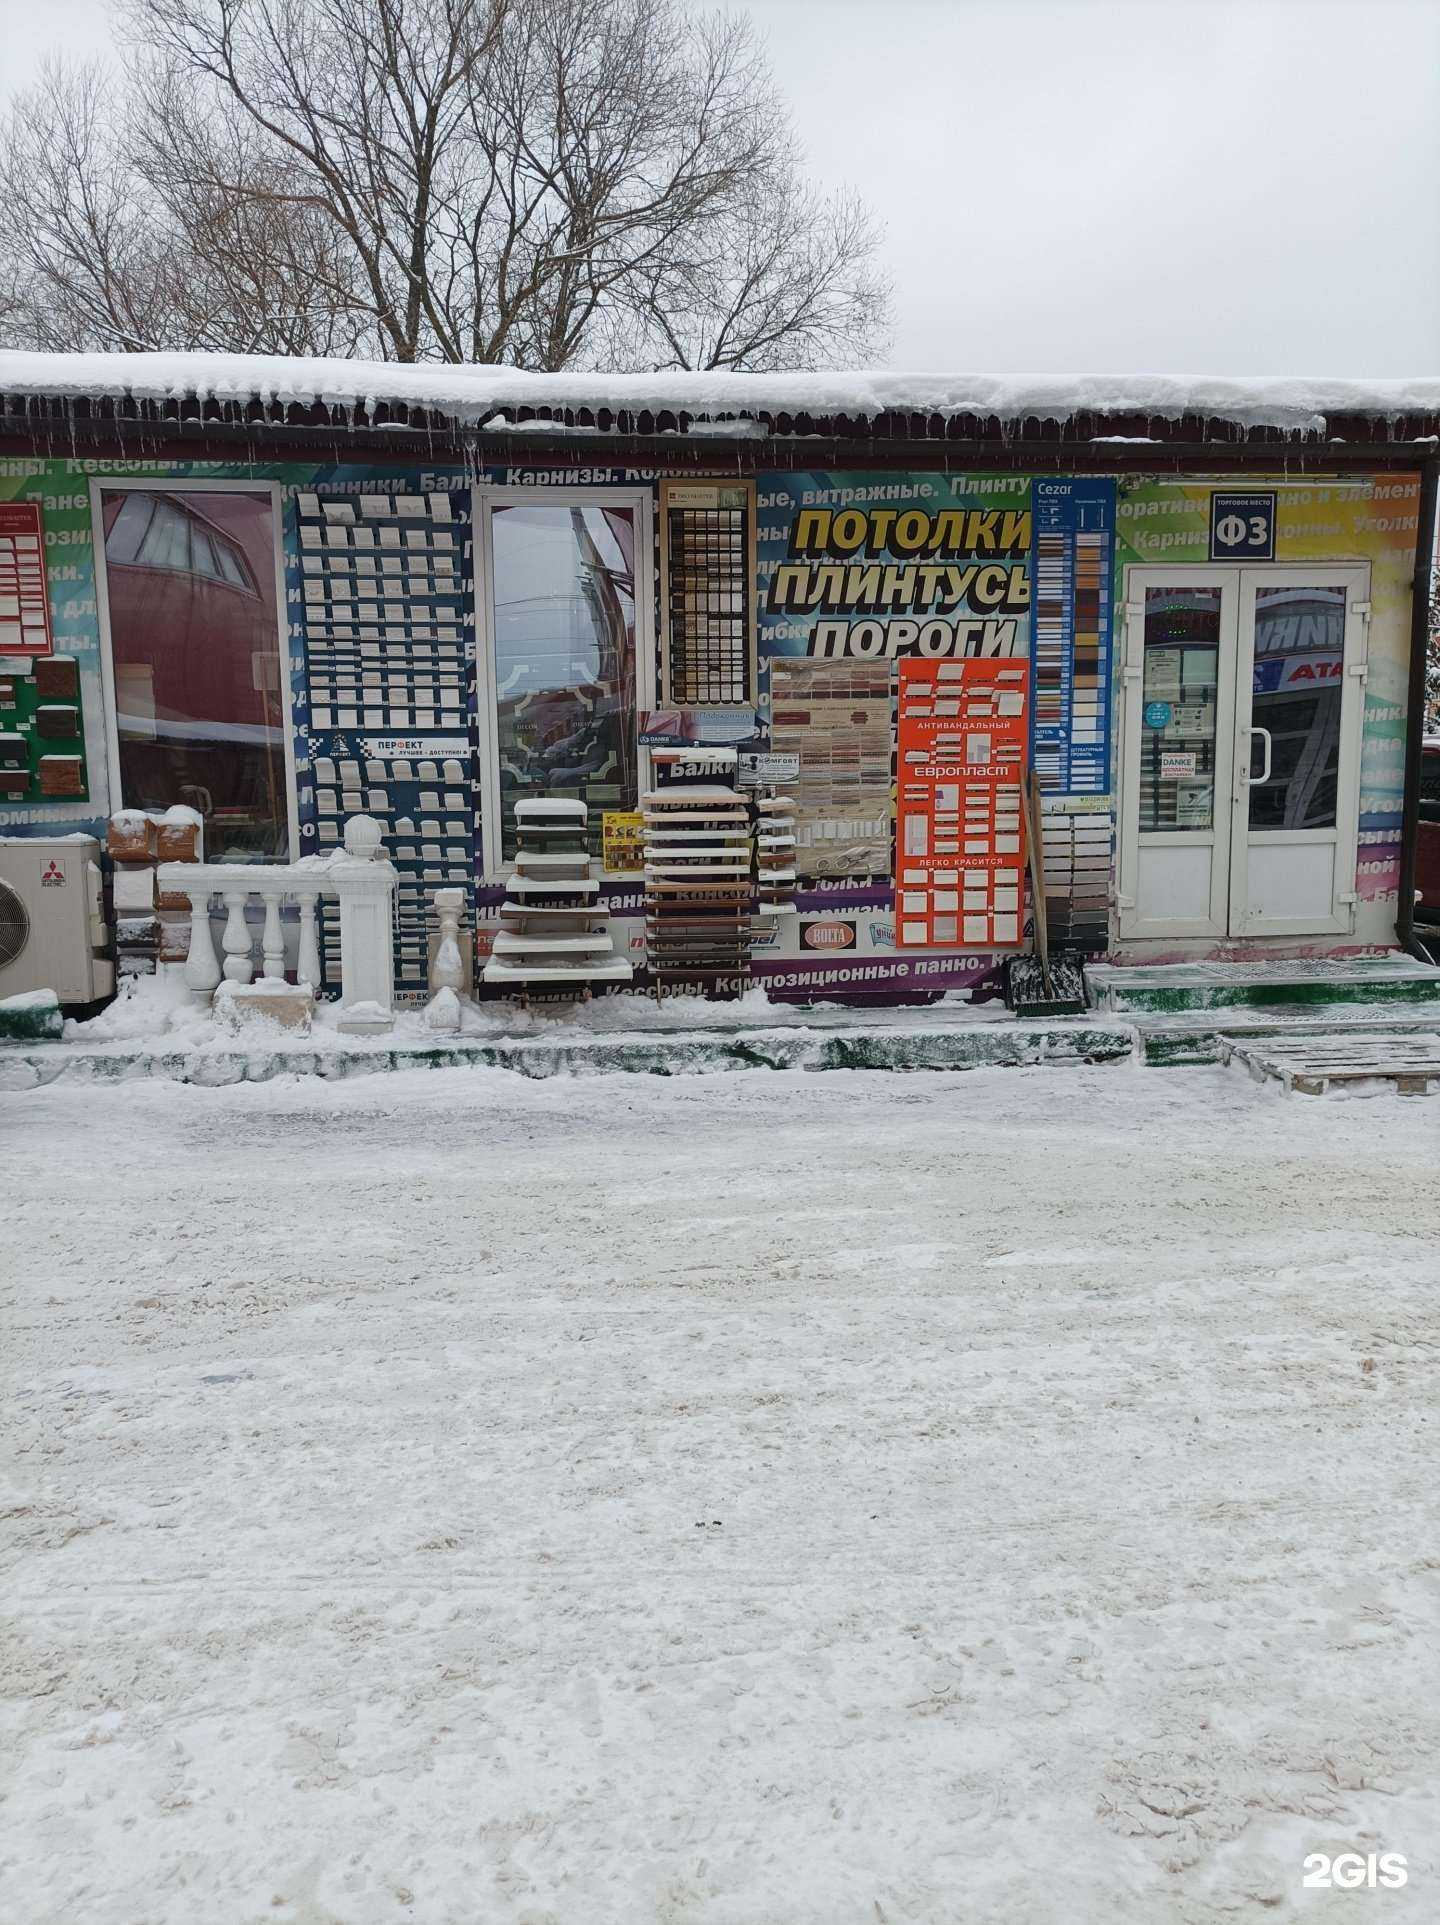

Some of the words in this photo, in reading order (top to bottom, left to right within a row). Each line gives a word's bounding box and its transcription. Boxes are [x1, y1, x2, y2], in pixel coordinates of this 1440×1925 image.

[803, 482, 939, 505] витражные.
[1038, 483, 1073, 495] Cezar
[793, 508, 1032, 551] ПОТОЛКИ
[812, 620, 1014, 658] ПОРОГИ
[917, 721, 1010, 730] АНТИВАНДАЛЬНЫЙ
[378, 740, 424, 750] ПЕРФЕКТ
[1163, 759, 1192, 767] DANKE
[920, 859, 950, 867] ЛЕГКО
[954, 858, 1004, 867] КРАСИТСЯ
[915, 957, 985, 975] панно.
